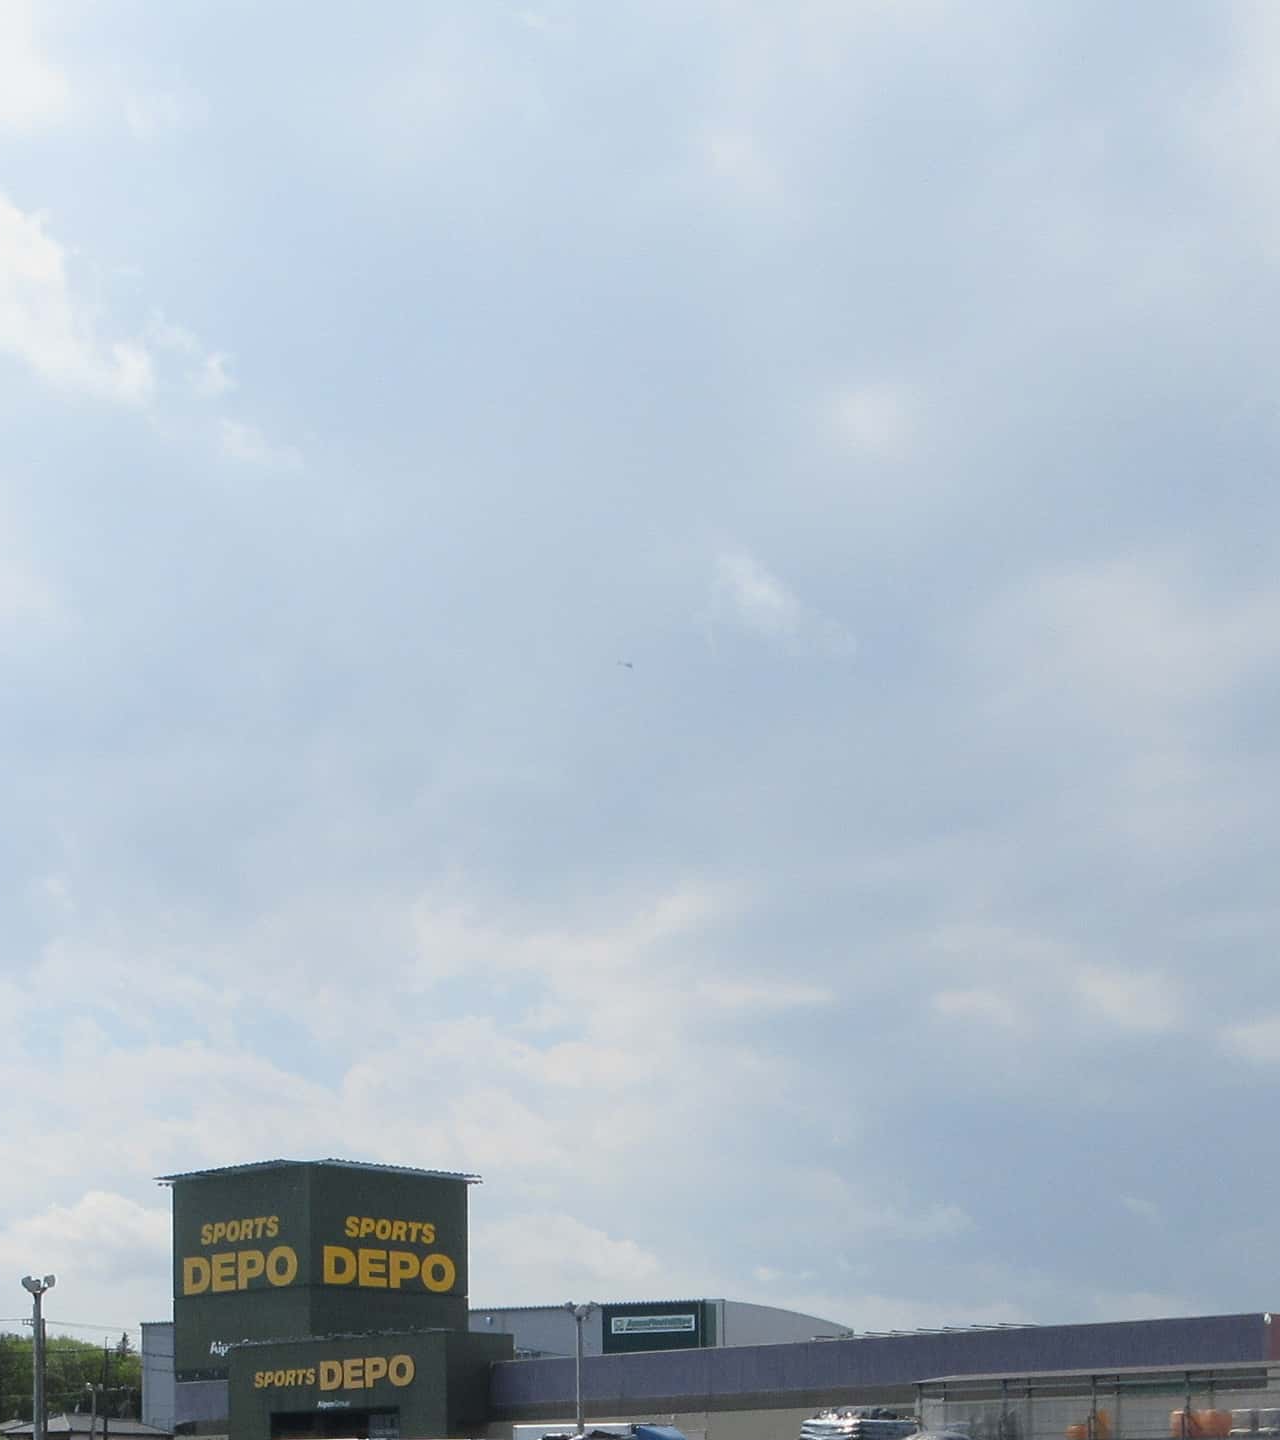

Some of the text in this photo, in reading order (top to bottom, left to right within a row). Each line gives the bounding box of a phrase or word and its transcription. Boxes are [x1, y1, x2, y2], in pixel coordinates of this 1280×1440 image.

[201, 1215, 280, 1246] SPORTS
[345, 1215, 436, 1245] SPORTS
[183, 1245, 299, 1296] DEPO
[323, 1244, 457, 1293] DEPO
[254, 1353, 416, 1392] SPORTS DEPO
